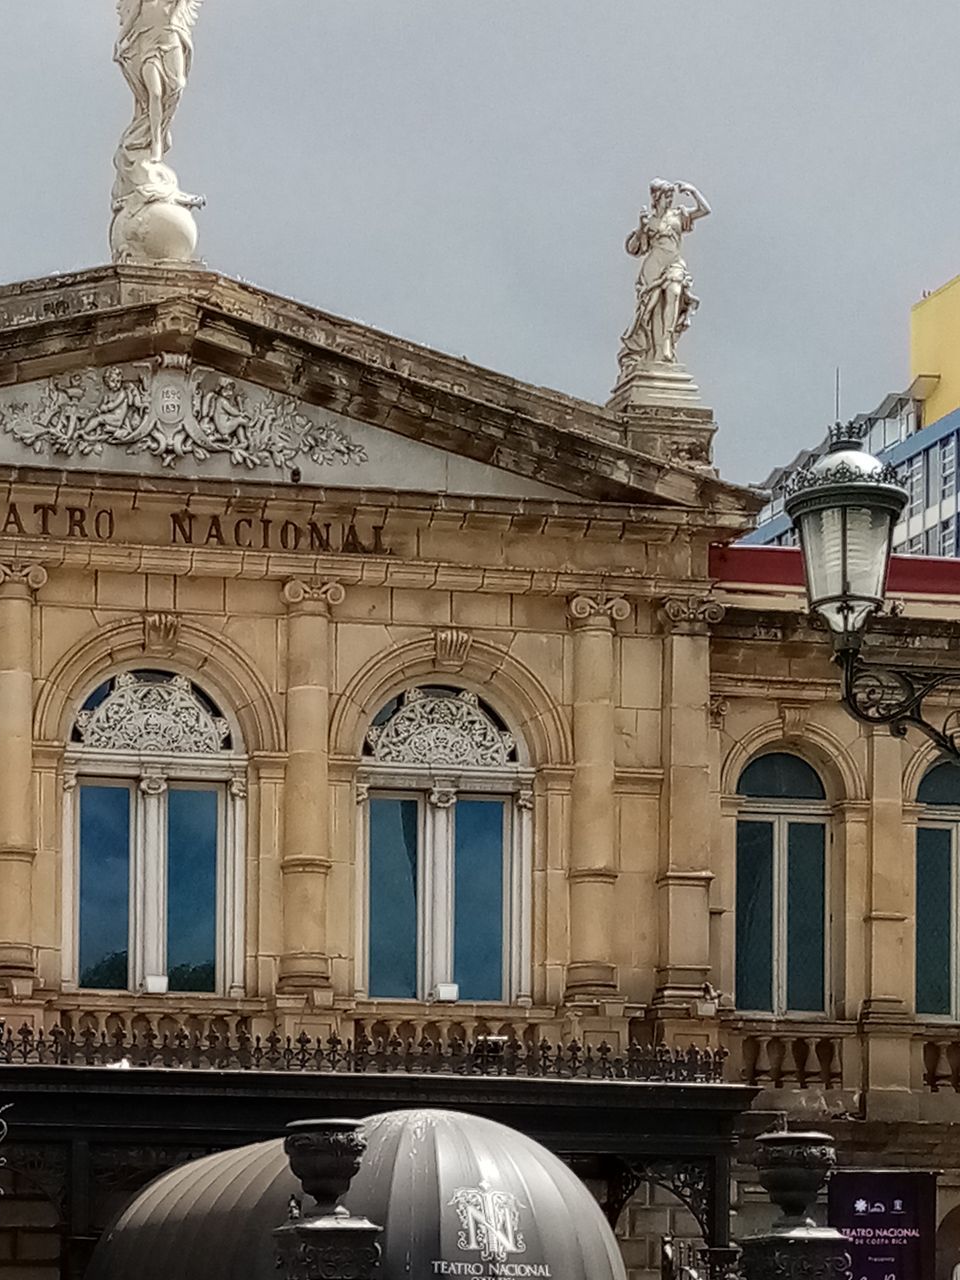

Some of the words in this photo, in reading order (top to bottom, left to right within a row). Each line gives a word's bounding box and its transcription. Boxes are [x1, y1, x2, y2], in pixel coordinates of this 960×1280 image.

[170, 512, 393, 556] NACIONAL
[841, 1227, 874, 1238] TEATRO
[875, 1227, 920, 1238] NACIONAL
[432, 1260, 484, 1275] TEATRO
[488, 1263, 552, 1277] NACIONAL
